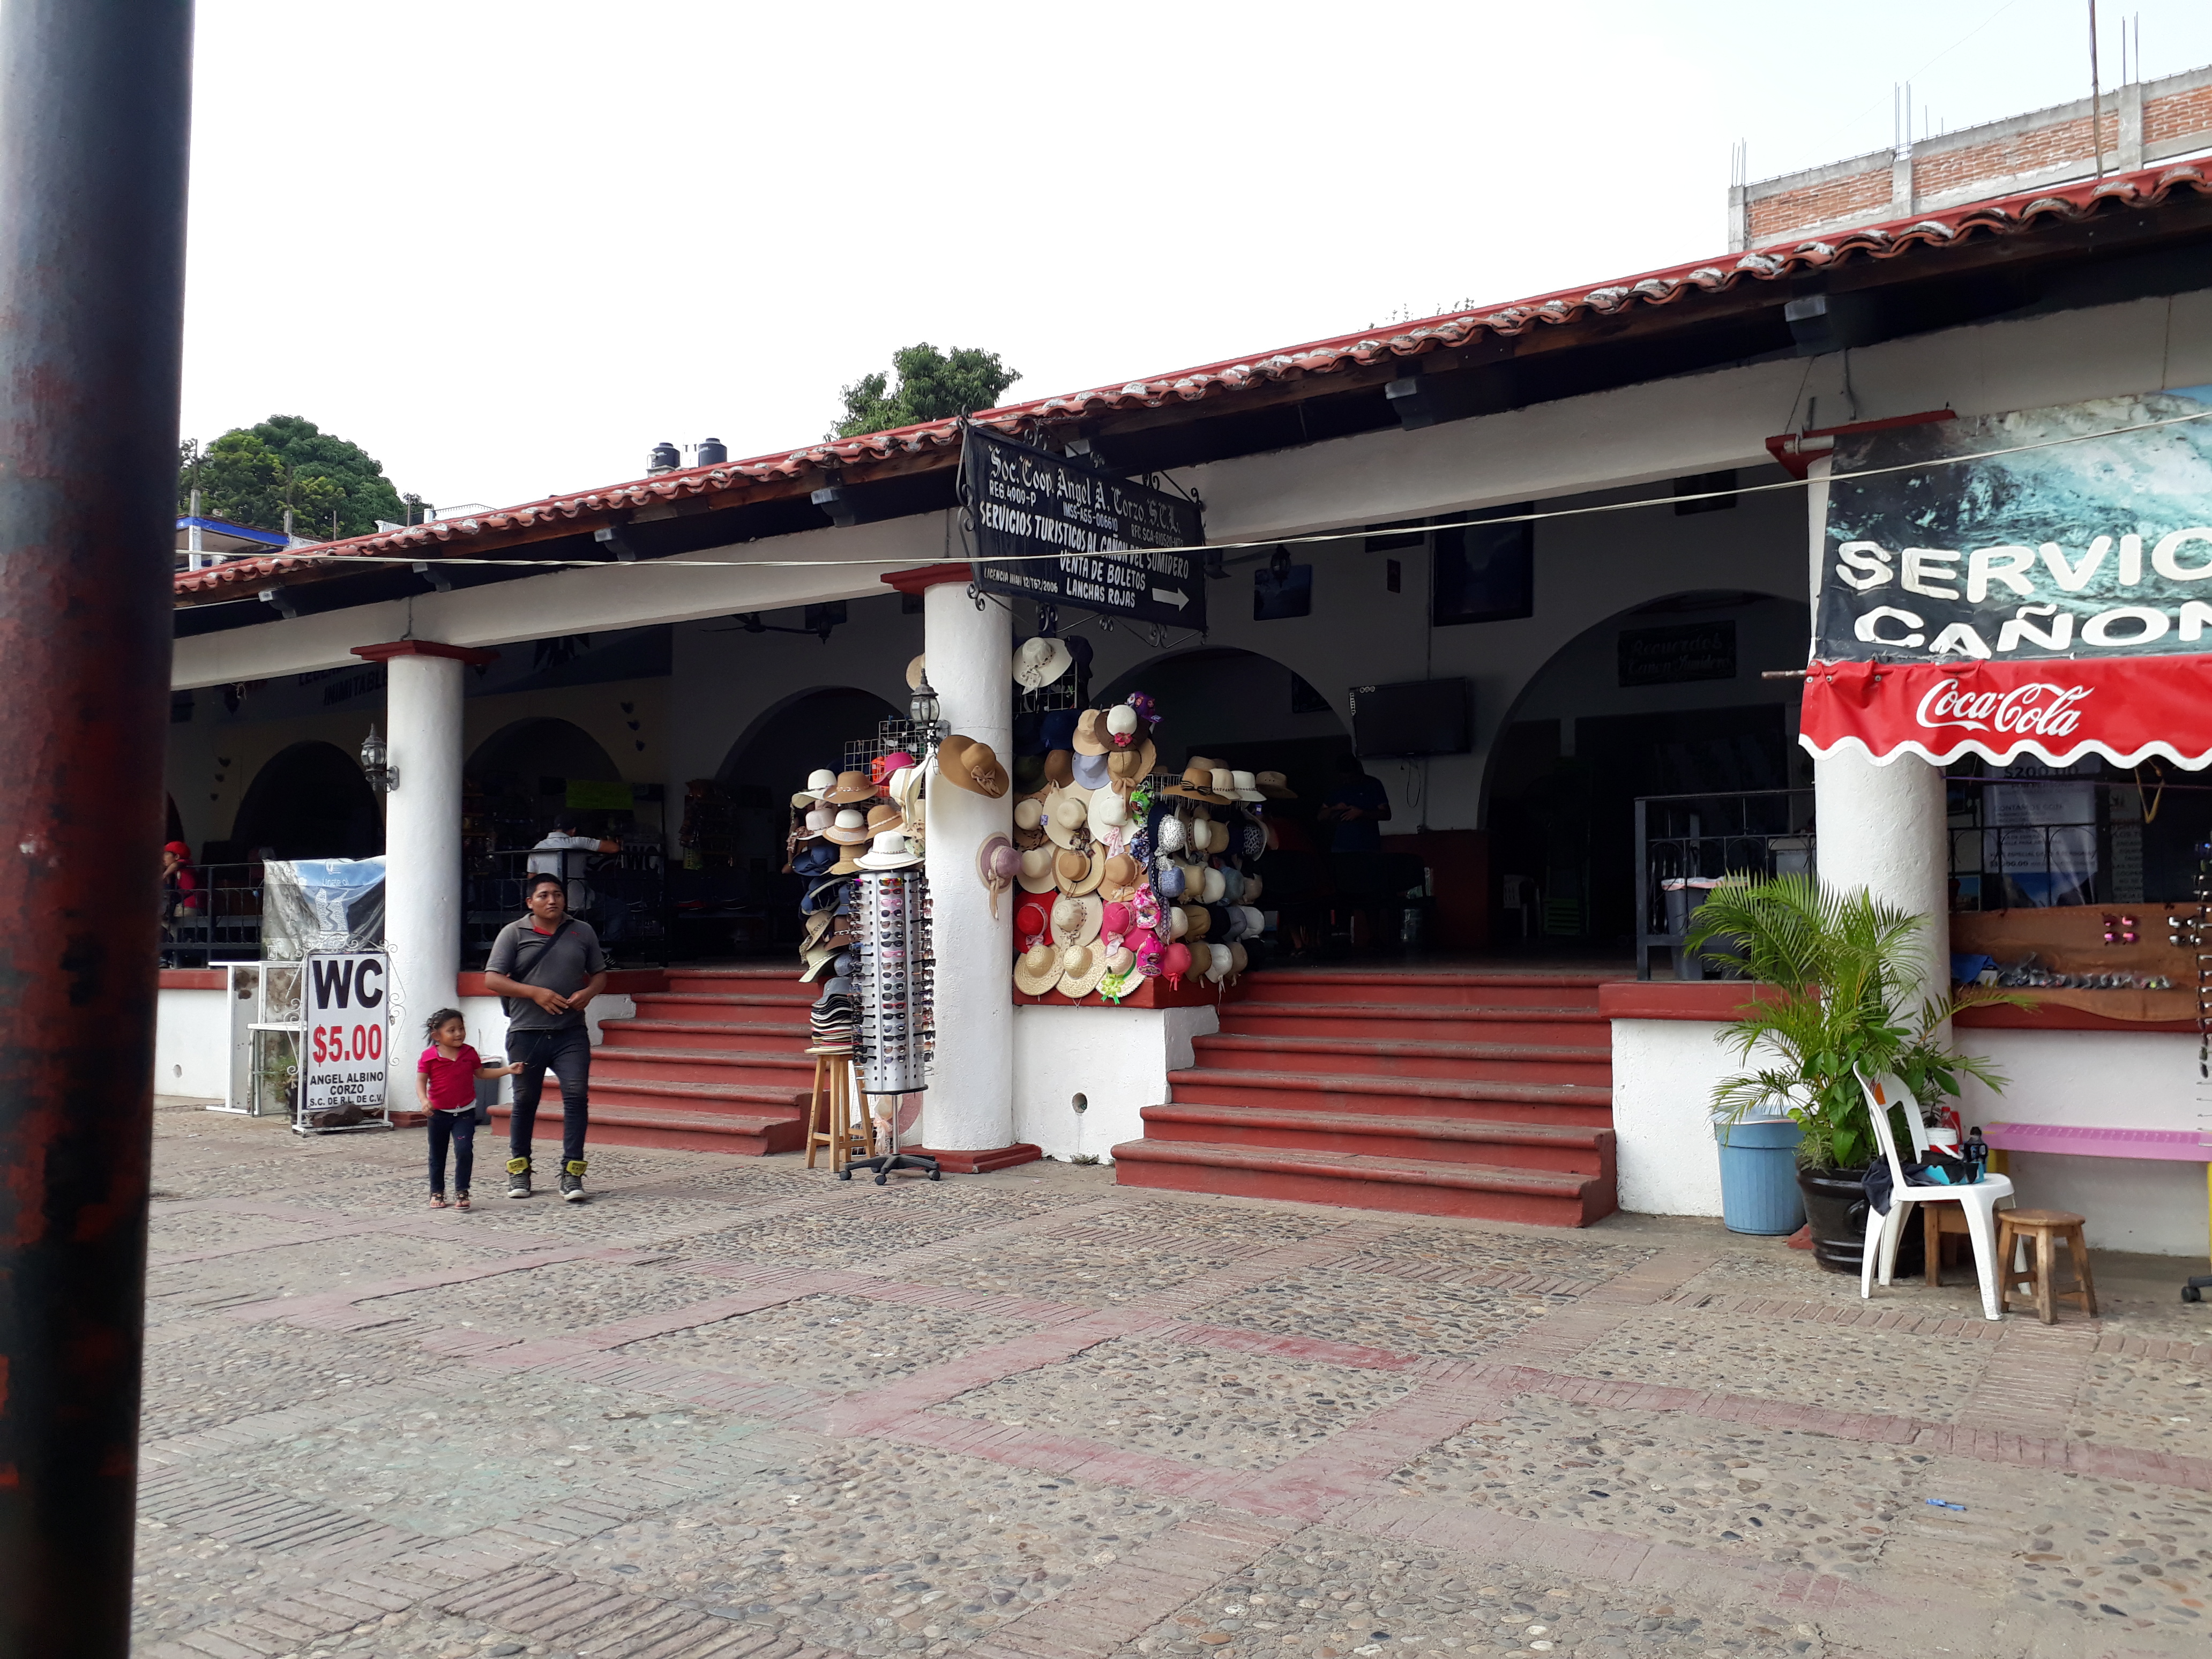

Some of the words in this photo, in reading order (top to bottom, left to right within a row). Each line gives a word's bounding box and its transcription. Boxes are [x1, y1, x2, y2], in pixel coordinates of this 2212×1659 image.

[988, 444, 1020, 484] Soc.
[1019, 455, 1055, 498] Coop.
[1057, 468, 1091, 507] Angel
[1094, 482, 1110, 513] A.
[979, 500, 1033, 537] SERVICIOS
[1034, 514, 1086, 552] TURISTICOS
[1087, 530, 1097, 554] AL
[1100, 533, 1129, 564] CAÑON
[1128, 544, 1145, 569] DEL
[1146, 550, 1190, 580] SUMIDERO
[983, 567, 1008, 584] LICENCIA
[1059, 549, 1088, 579] VENTA
[1091, 560, 1103, 582] DE
[1107, 564, 1146, 591] BOLETOS
[1066, 577, 1104, 602] LANCHAS
[1107, 587, 1135, 608] ROJAS
[1916, 678, 2096, 737] Coca-Cola
[312, 959, 383, 1009] WC
[312, 1024, 382, 1067] $5.00
[310, 1073, 343, 1085] ANGEL
[347, 1072, 384, 1083] ALBINO
[330, 1084, 364, 1095] CORZO
[310, 1098, 325, 1106] S.C.
[327, 1097, 338, 1105] DE
[340, 1096, 354, 1104] R.L.
[356, 1095, 367, 1103] DE
[369, 1094, 383, 1102] C.V.
